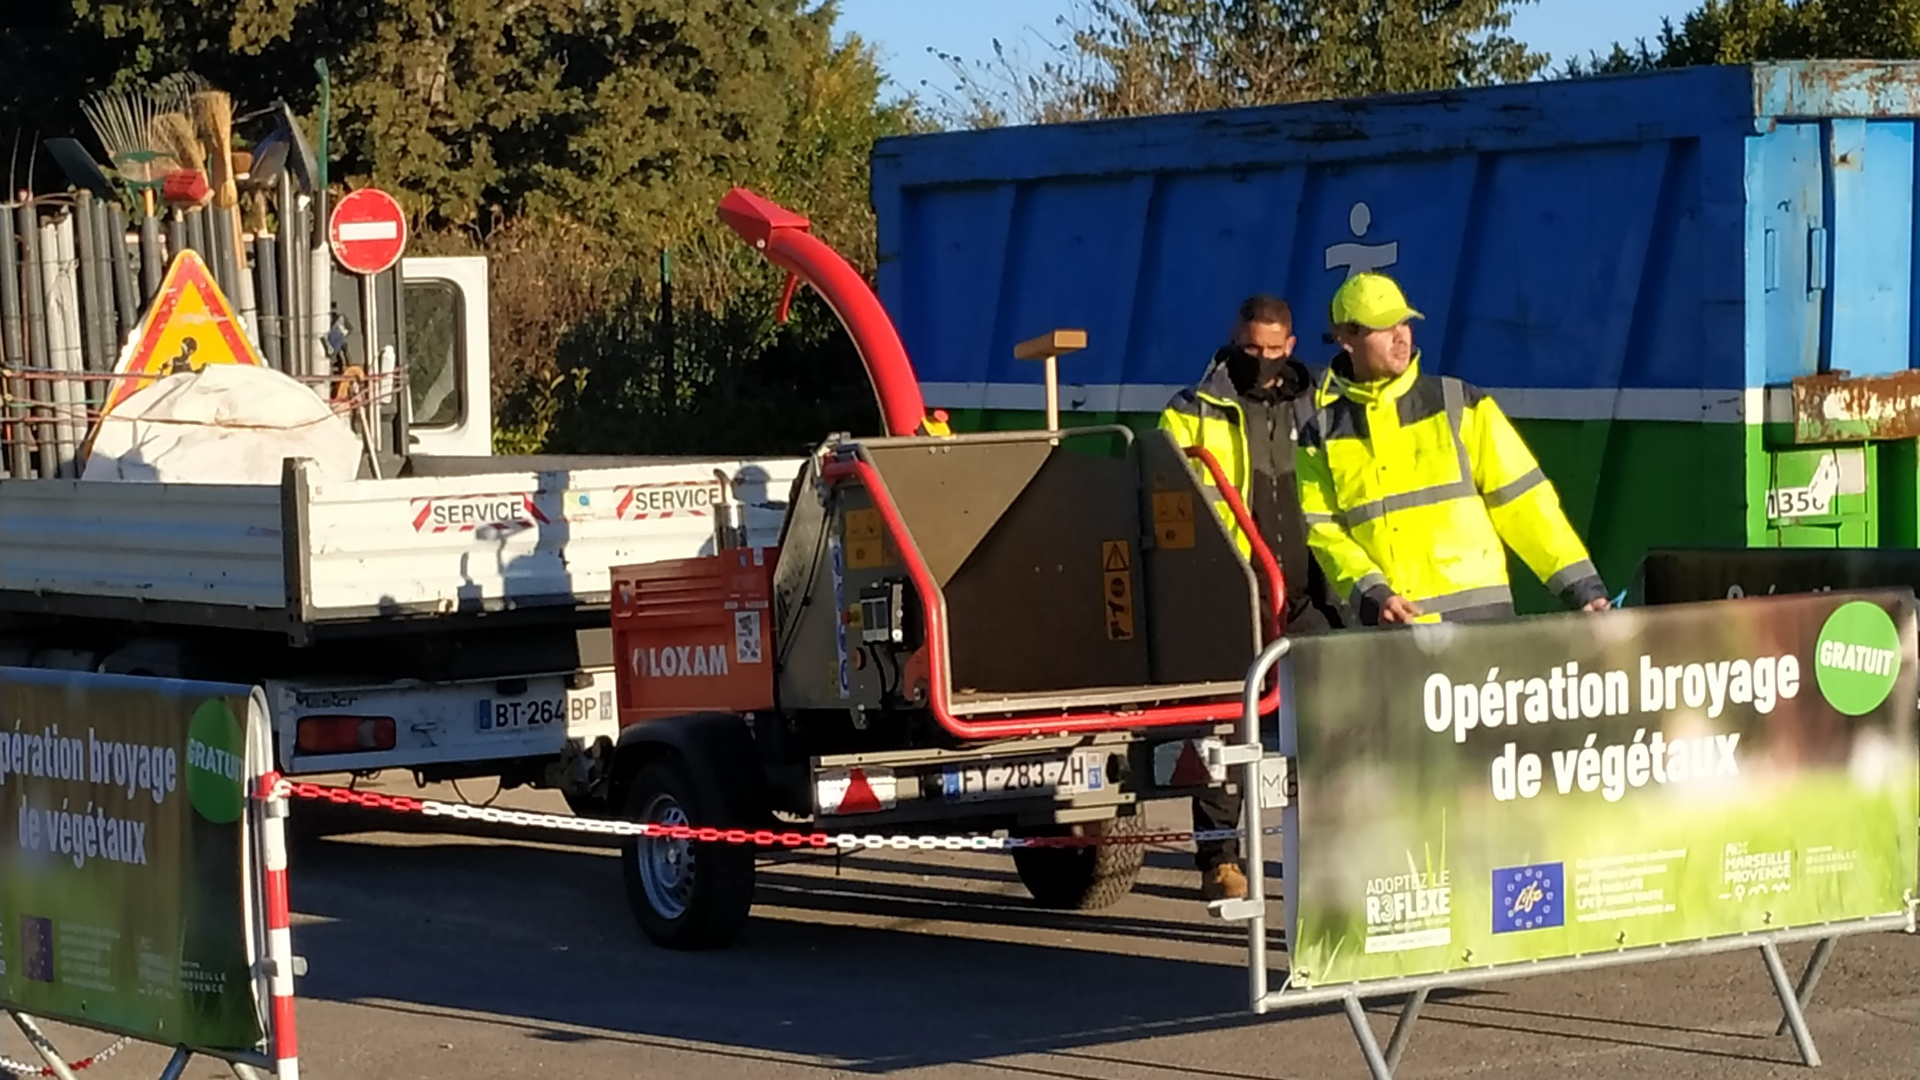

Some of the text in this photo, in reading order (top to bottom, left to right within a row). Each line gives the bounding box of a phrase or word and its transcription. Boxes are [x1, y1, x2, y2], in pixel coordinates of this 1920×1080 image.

[433, 501, 524, 525] SERVICE
[635, 488, 719, 511] SERVICE
[650, 645, 728, 677] LOXAM
[1820, 639, 1895, 677] GRATUIT
[1423, 654, 1800, 743] Opération broyage
[0, 719, 176, 804] pération broyage
[1492, 728, 1741, 802] de végétaux
[46, 797, 147, 869] végétaux
[1725, 850, 1791, 870] MARSEILLE
[1725, 864, 1791, 885] PROVENCE
[1366, 870, 1450, 895] ADOPTEZ LE
[1366, 887, 1451, 924] R3FLEXE
